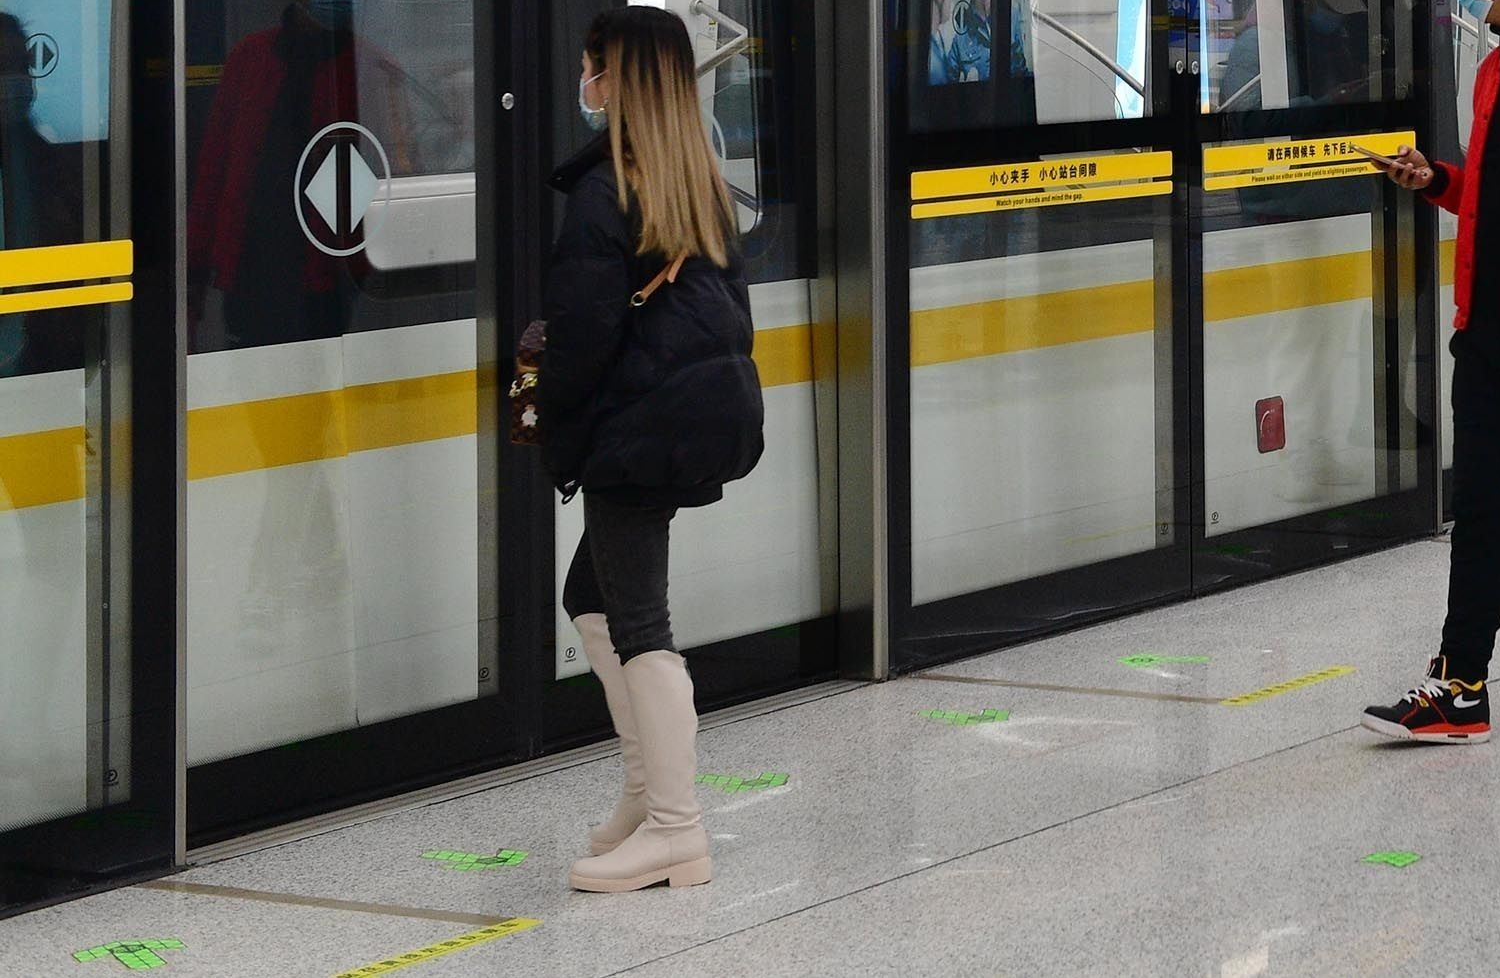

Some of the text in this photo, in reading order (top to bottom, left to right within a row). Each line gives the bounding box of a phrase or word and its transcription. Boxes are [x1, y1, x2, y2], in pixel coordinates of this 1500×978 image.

[1267, 141, 1355, 162] 请在两侧候车 先下后上
[989, 162, 1097, 186] 小心夹手 小心站台间隙
